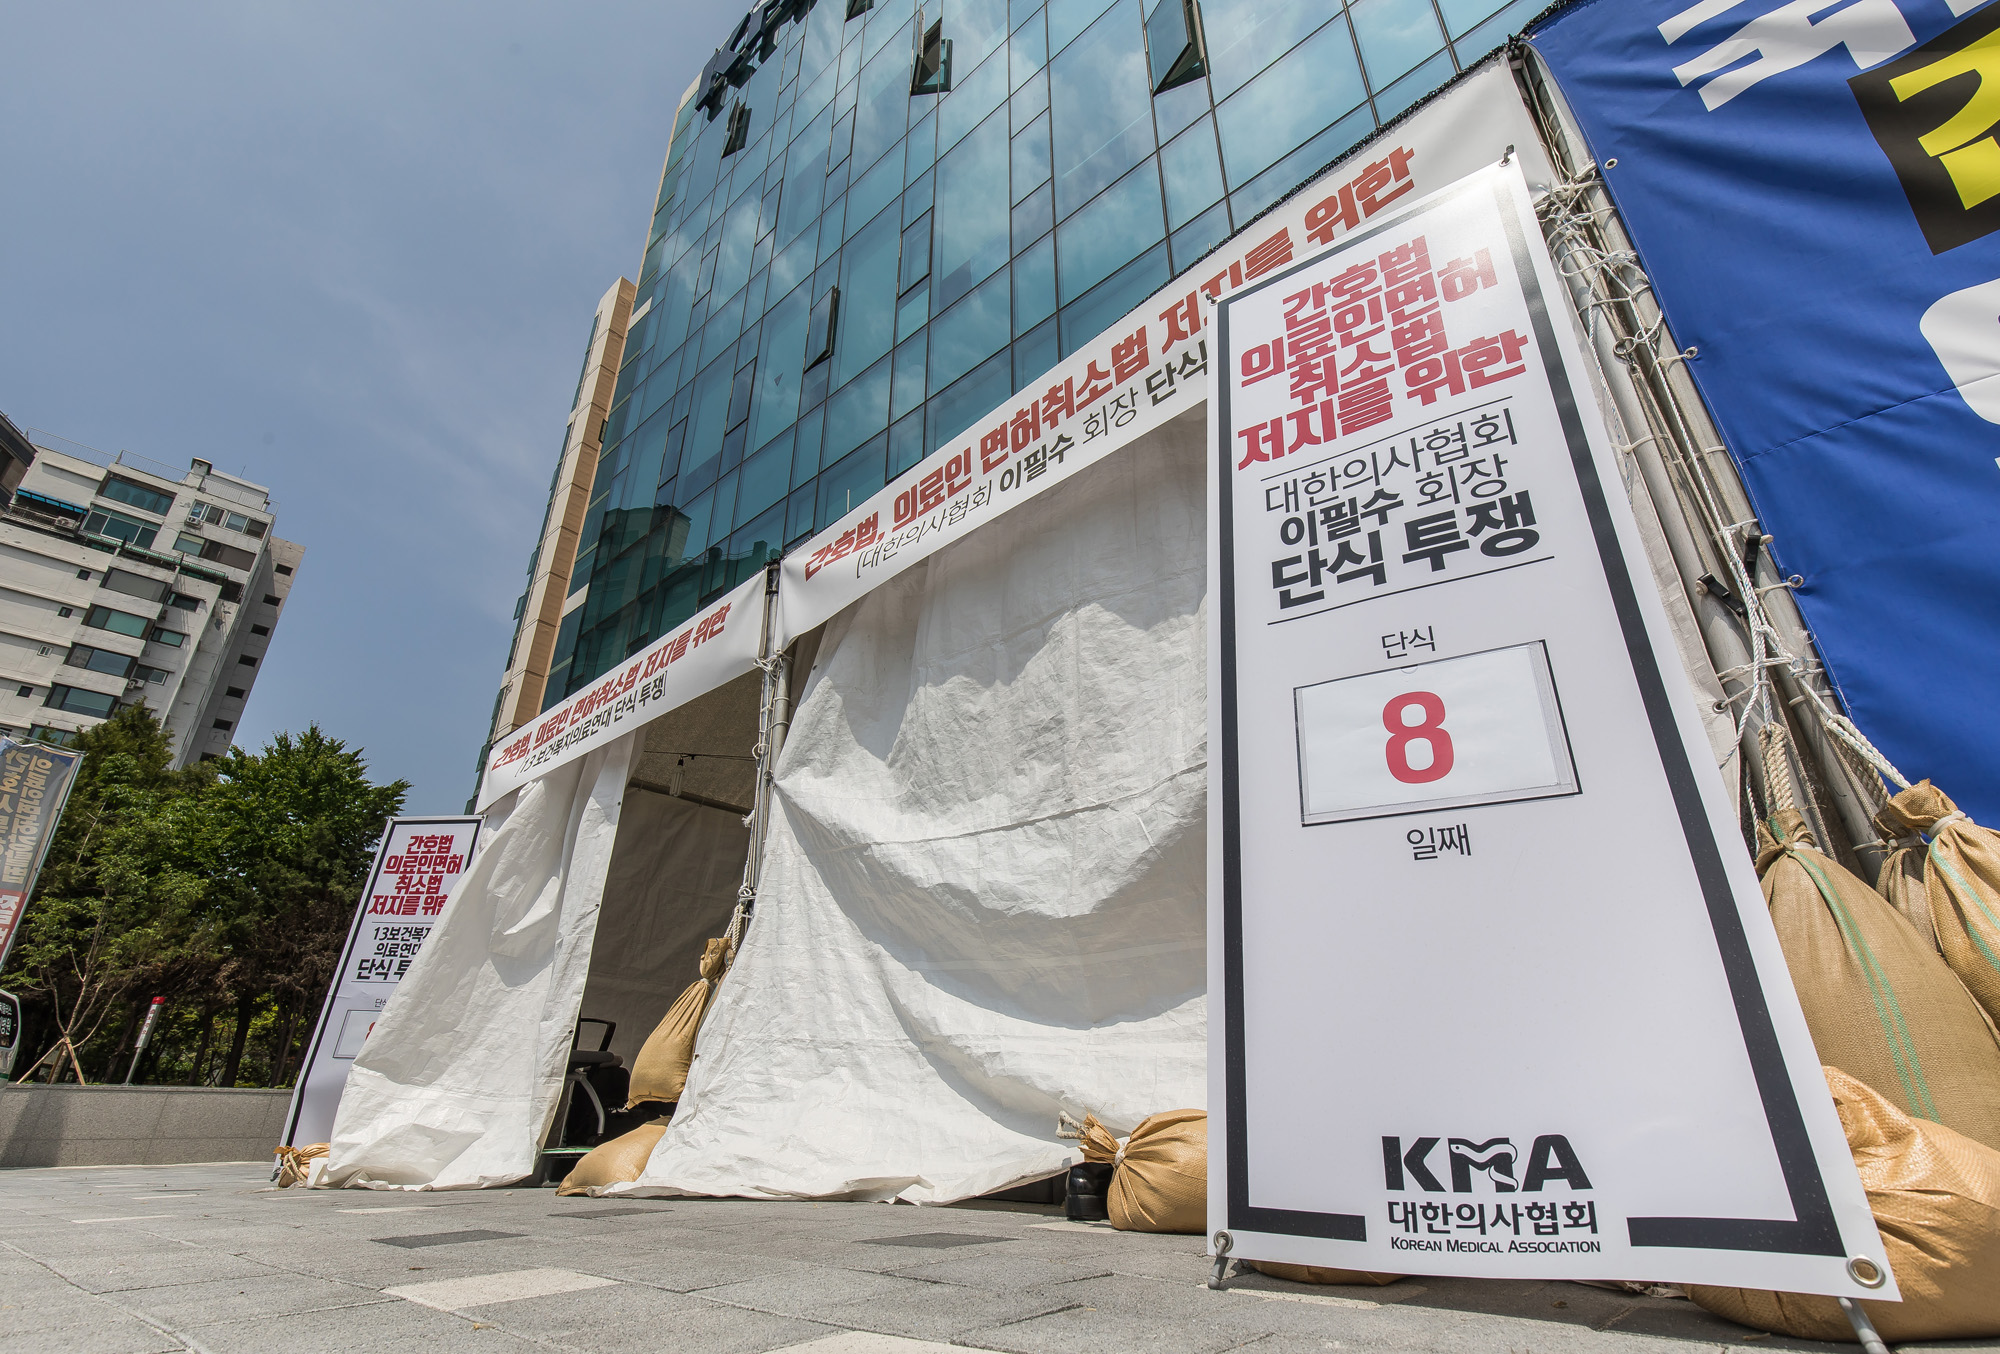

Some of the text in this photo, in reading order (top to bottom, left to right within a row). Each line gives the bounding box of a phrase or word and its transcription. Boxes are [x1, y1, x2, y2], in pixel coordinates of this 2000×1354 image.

[1241, 247, 1498, 388] 의료인면허
[1283, 235, 1432, 332] 간호법
[805, 511, 885, 582] 간호법,
[892, 447, 972, 532] 의료인
[980, 325, 1150, 475] 면허취소법
[1305, 146, 1415, 245] 위한
[1290, 310, 1449, 404] 취소법
[1000, 433, 1075, 492] 이필수
[1083, 387, 1138, 444] 회장
[1145, 339, 1207, 407] 단식
[1238, 329, 1528, 471] 저지를 위한
[1265, 408, 1518, 513] 대한의사협회
[1280, 453, 1508, 547] 이필수 회장
[1271, 489, 1540, 609] 단식 투쟁
[1381, 625, 1436, 659] 단식
[491, 601, 732, 771] 간호법, 의료인 면허취소법 저지를 위한
[614, 690, 638, 722] 단식
[1382, 691, 1454, 784] 8
[383, 854, 464, 875] 의료인면허
[406, 835, 454, 854] 간호법
[1406, 823, 1472, 861] 일째
[368, 895, 421, 915] 저지를
[395, 875, 443, 895] 취소법
[356, 959, 393, 980] 단식
[1381, 1134, 1594, 1193] KMA
[1387, 1201, 1598, 1236] 대한의사협회
[1391, 1236, 1601, 1253] KOREAN MEDICAL ASSOCIATION
